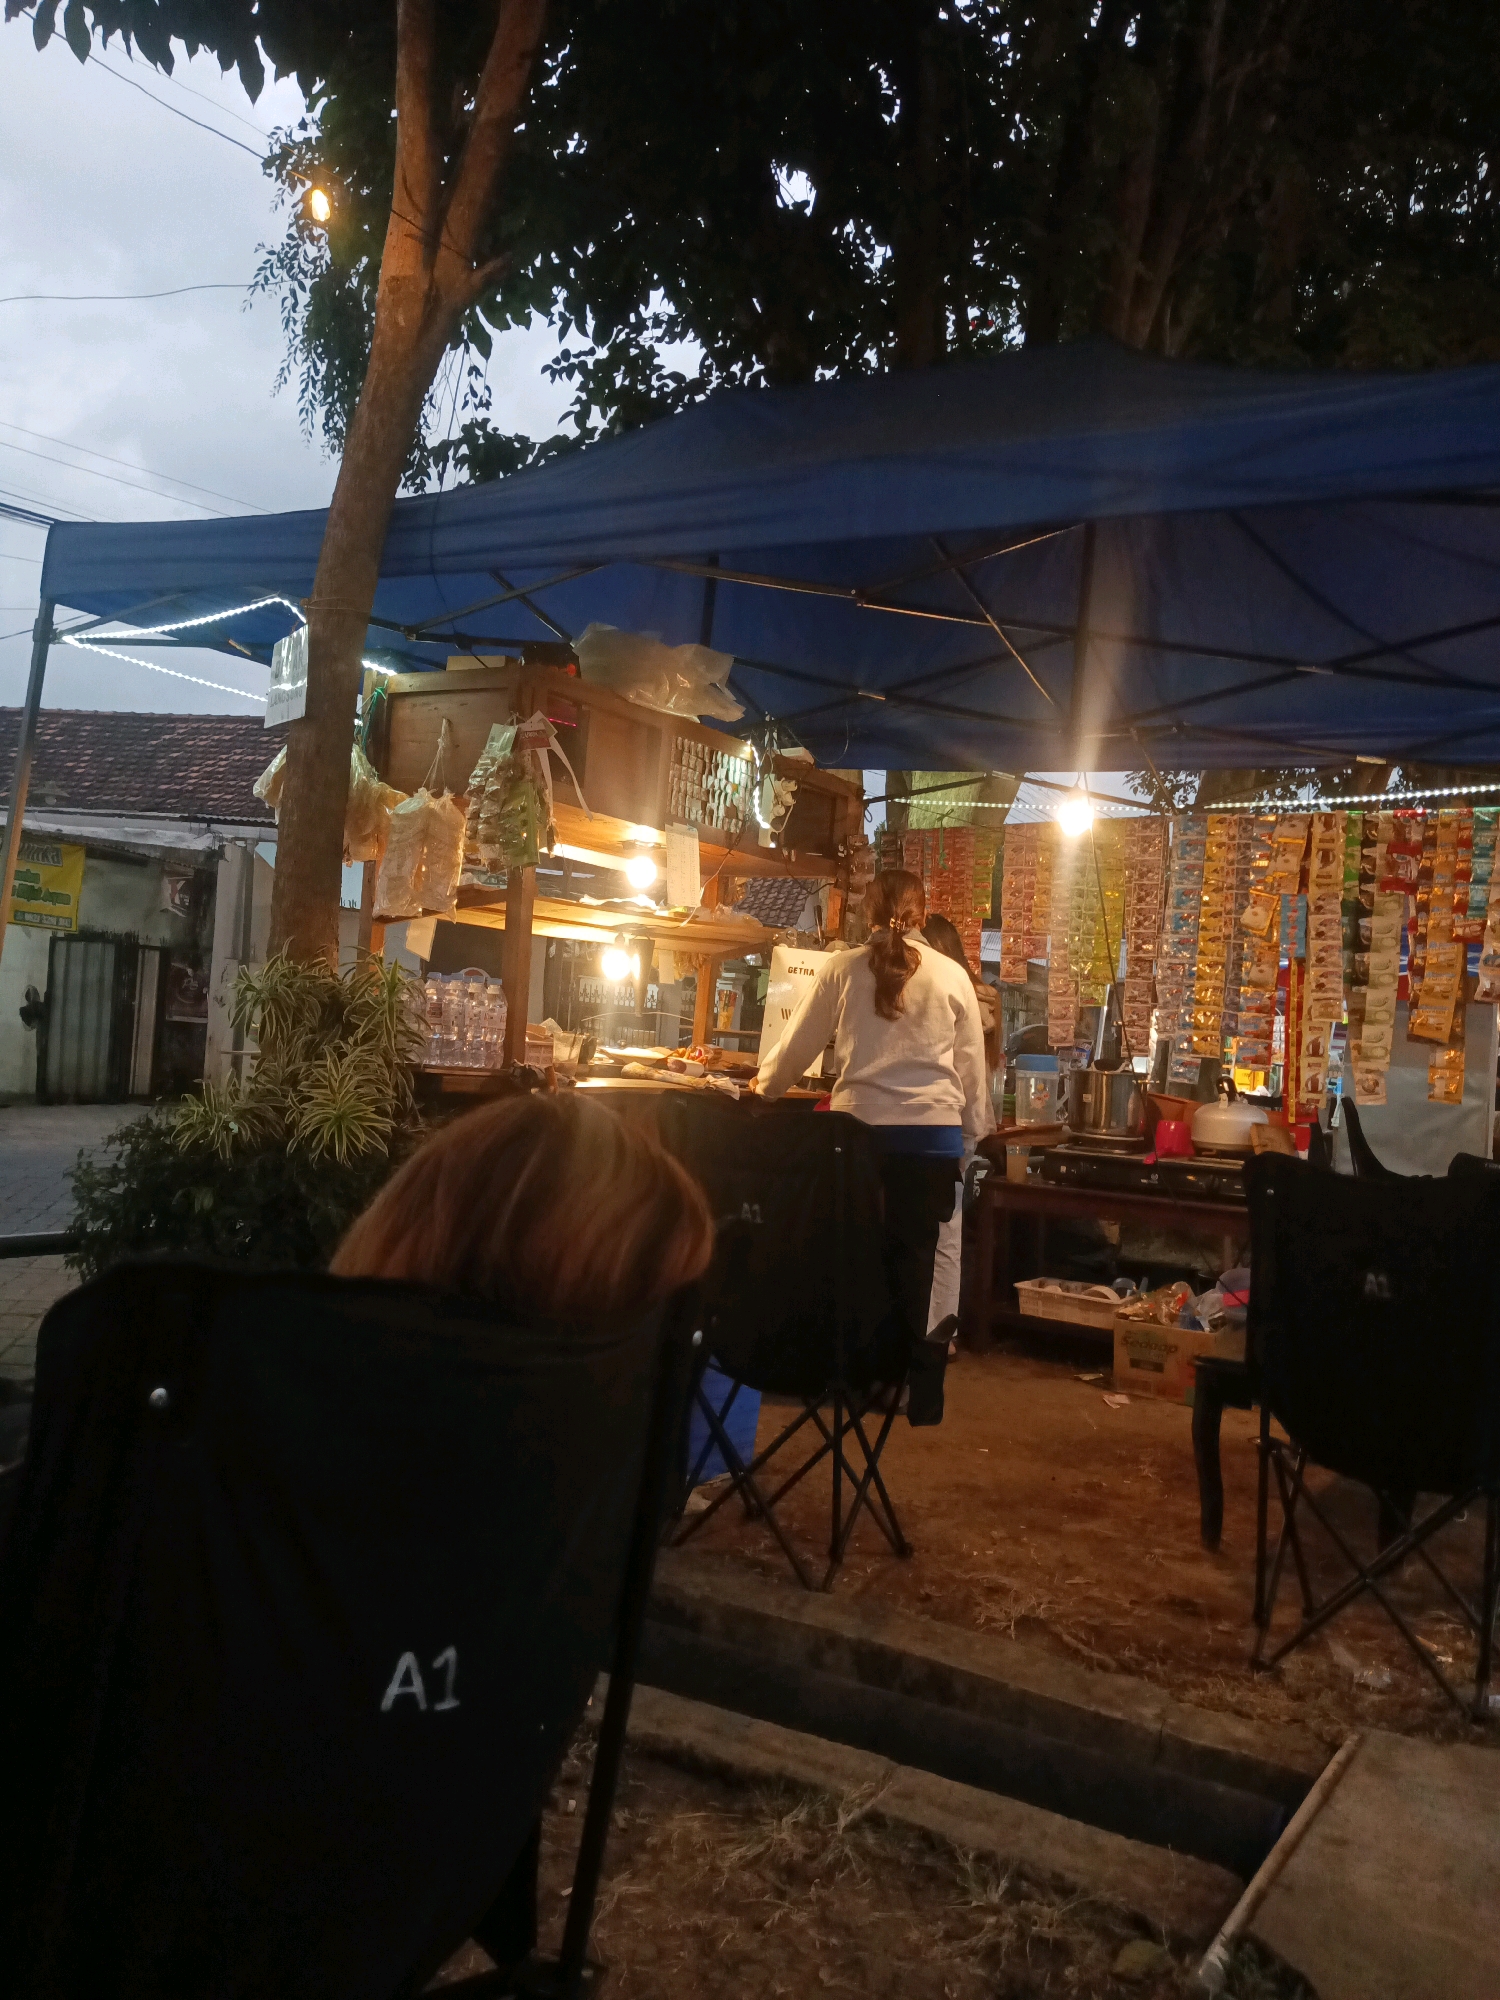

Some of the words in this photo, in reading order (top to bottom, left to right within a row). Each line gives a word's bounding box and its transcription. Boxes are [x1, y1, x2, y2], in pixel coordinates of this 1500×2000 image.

[787, 966, 815, 977] GETRA
[741, 1202, 764, 1224] A1
[380, 1644, 461, 1712] A1
